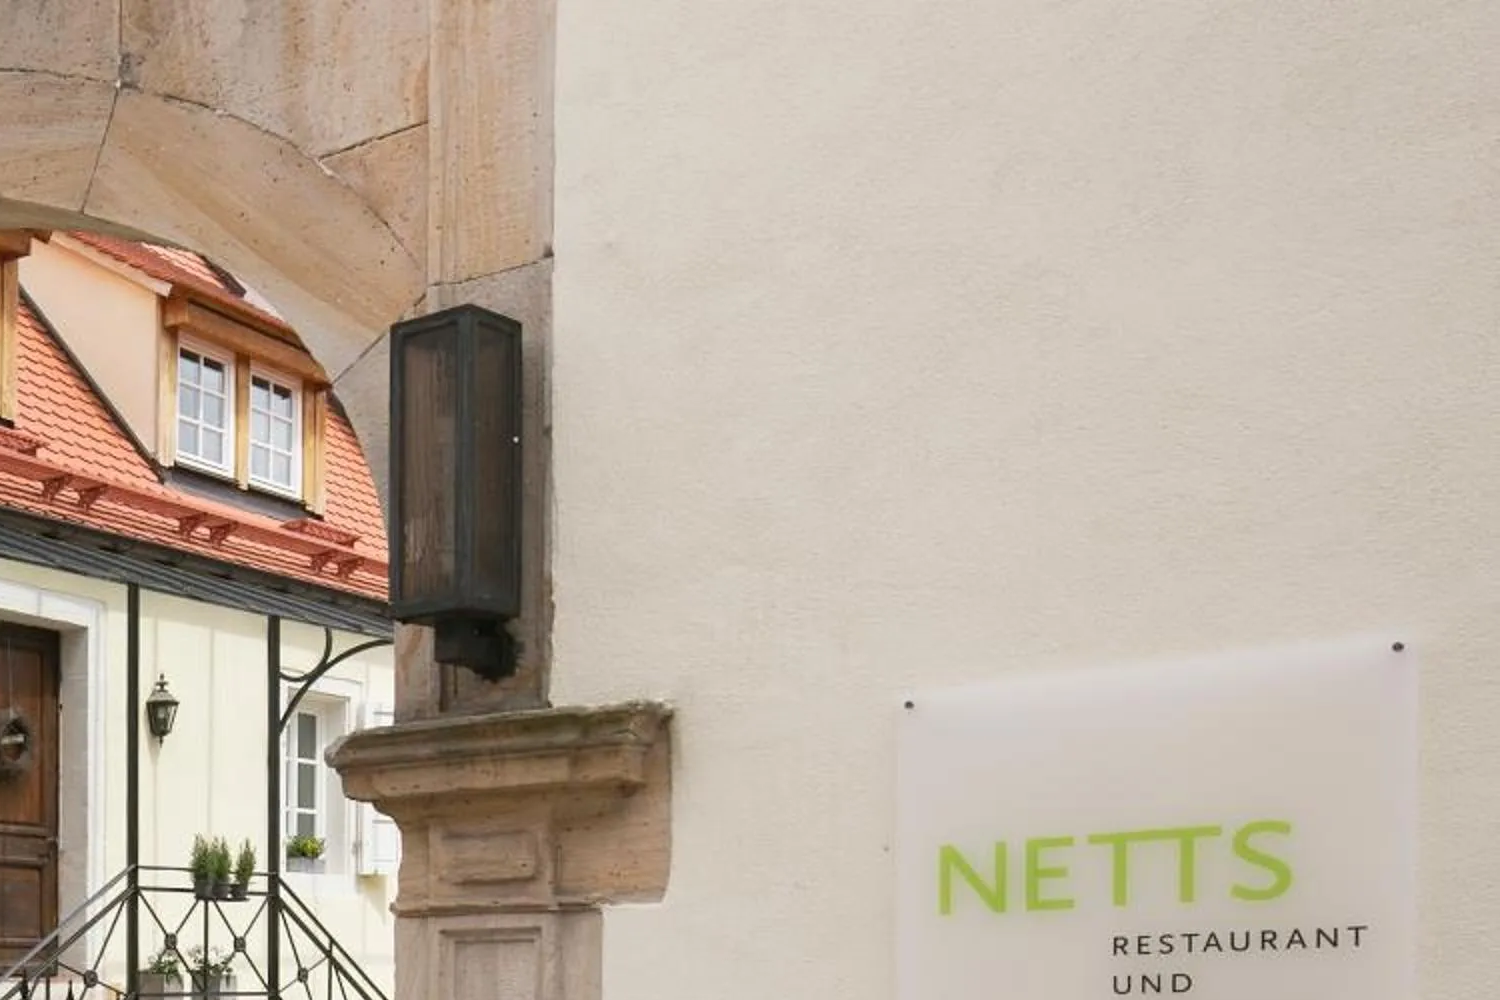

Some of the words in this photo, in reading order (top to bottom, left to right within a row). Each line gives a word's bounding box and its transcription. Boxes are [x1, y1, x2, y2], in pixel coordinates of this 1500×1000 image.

[938, 819, 1294, 916] NETTS
[1112, 925, 1369, 956] RESTAURANT
[1112, 972, 1193, 996] UND
